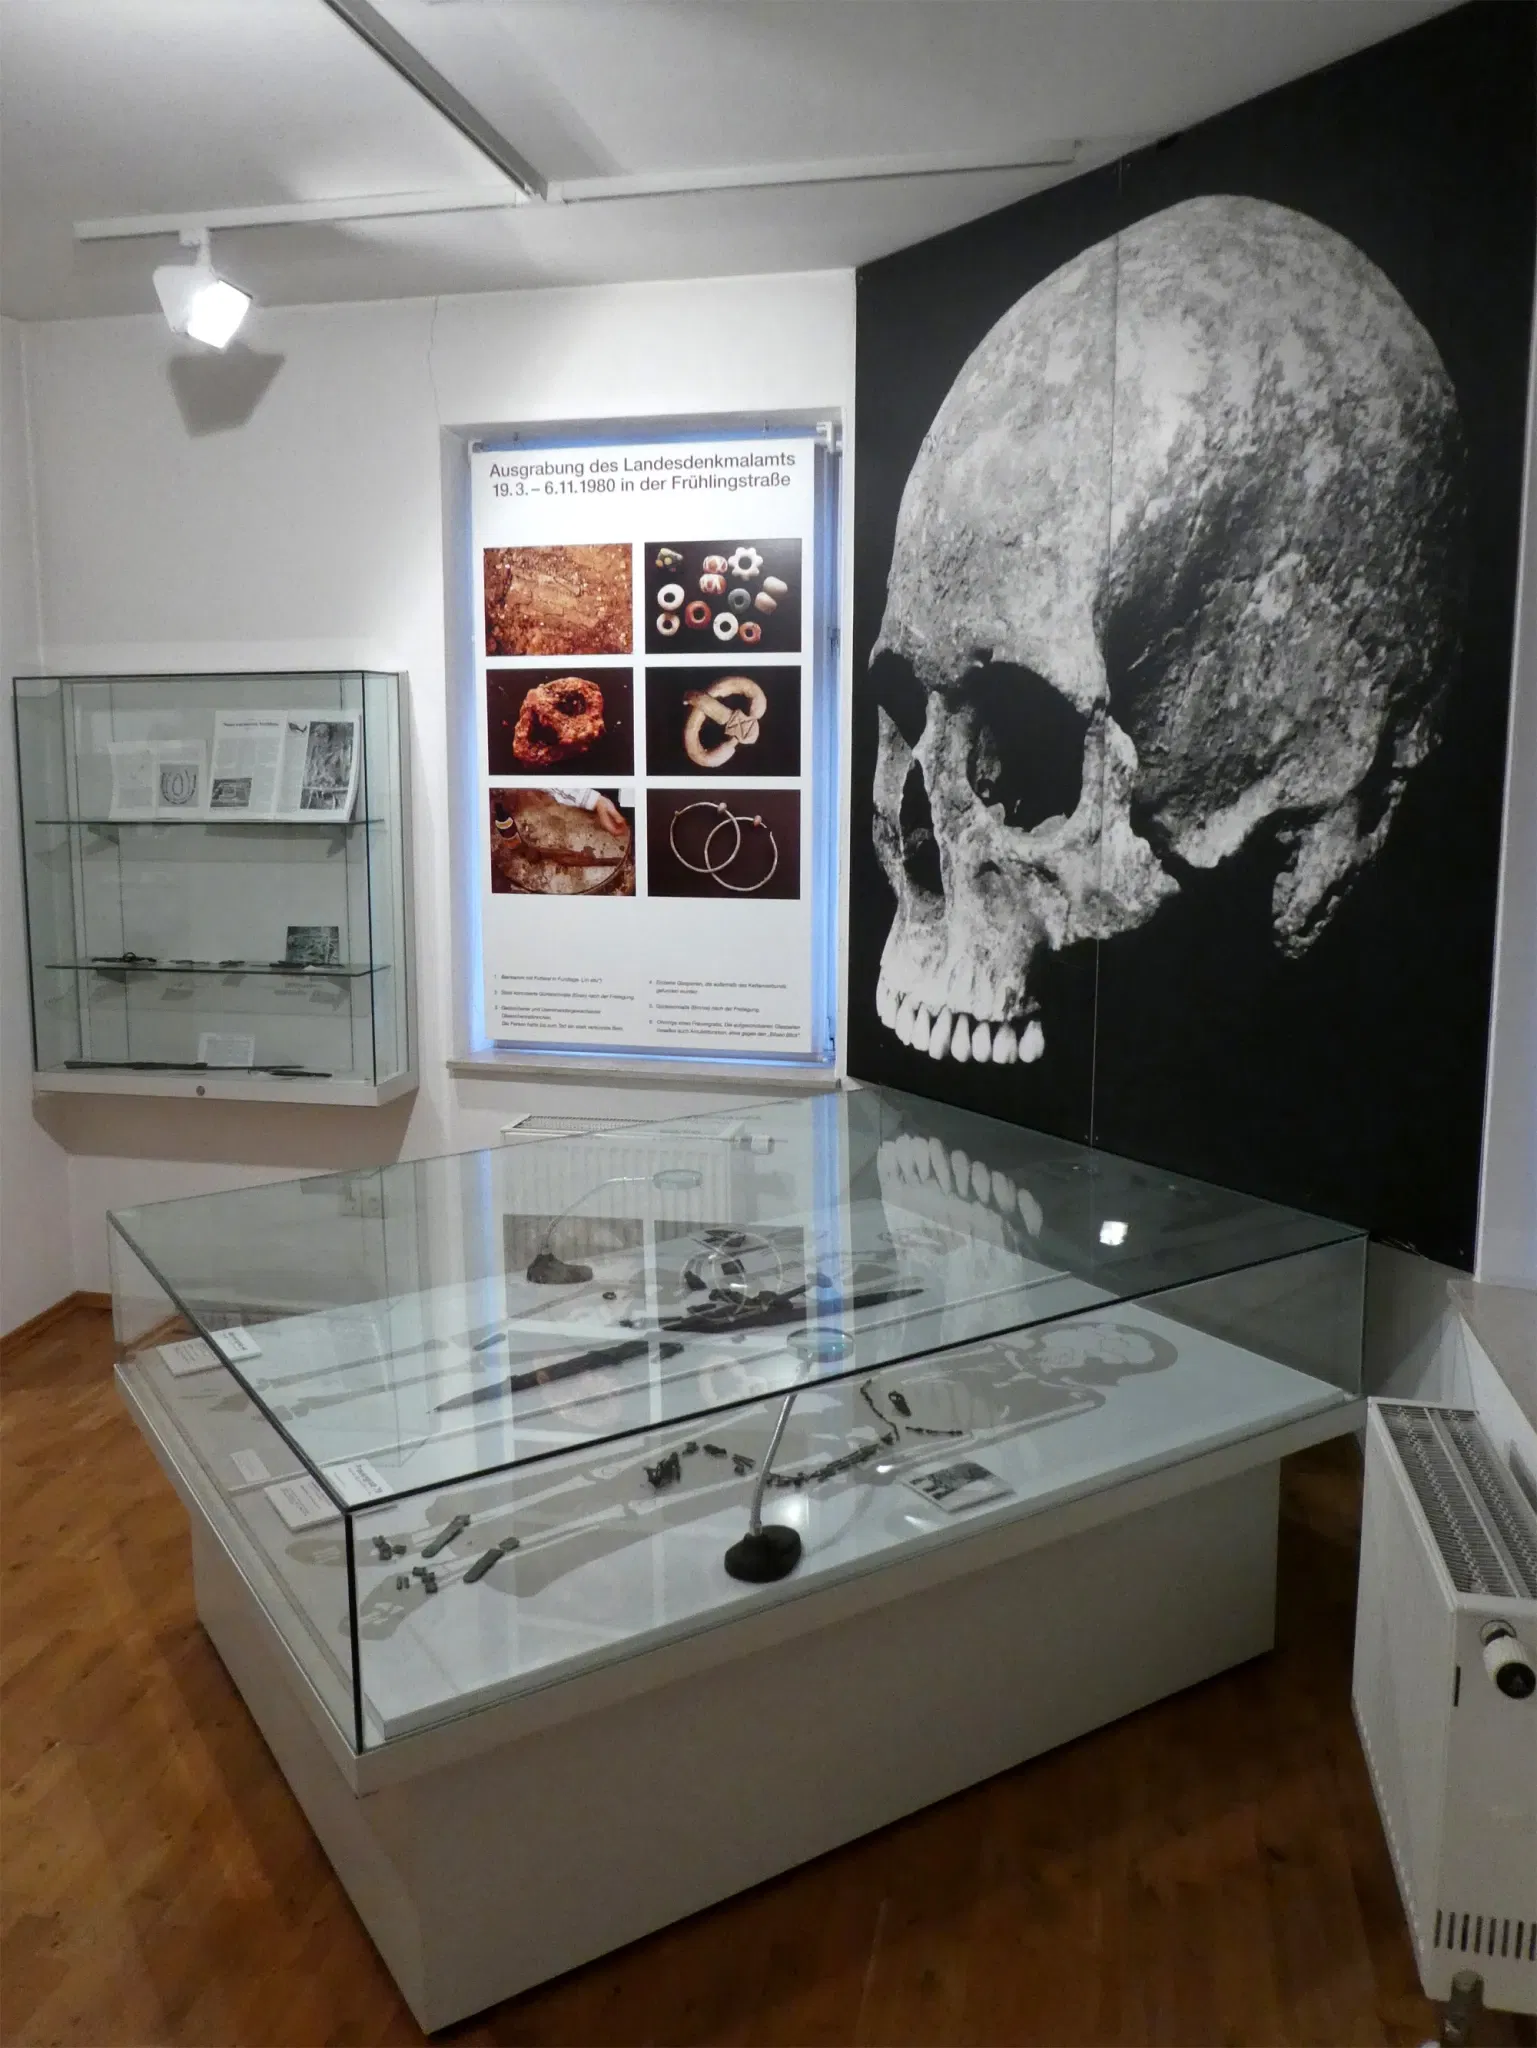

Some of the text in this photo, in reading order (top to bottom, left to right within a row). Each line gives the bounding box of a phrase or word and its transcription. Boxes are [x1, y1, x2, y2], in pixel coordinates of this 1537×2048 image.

[490, 452, 796, 479] Ausgrabung des Landesdenkmalamts
[544, 478, 616, 495] 6.11.1980
[621, 478, 634, 492] in
[640, 476, 667, 491] der
[672, 472, 791, 491] Frühlingstraße
